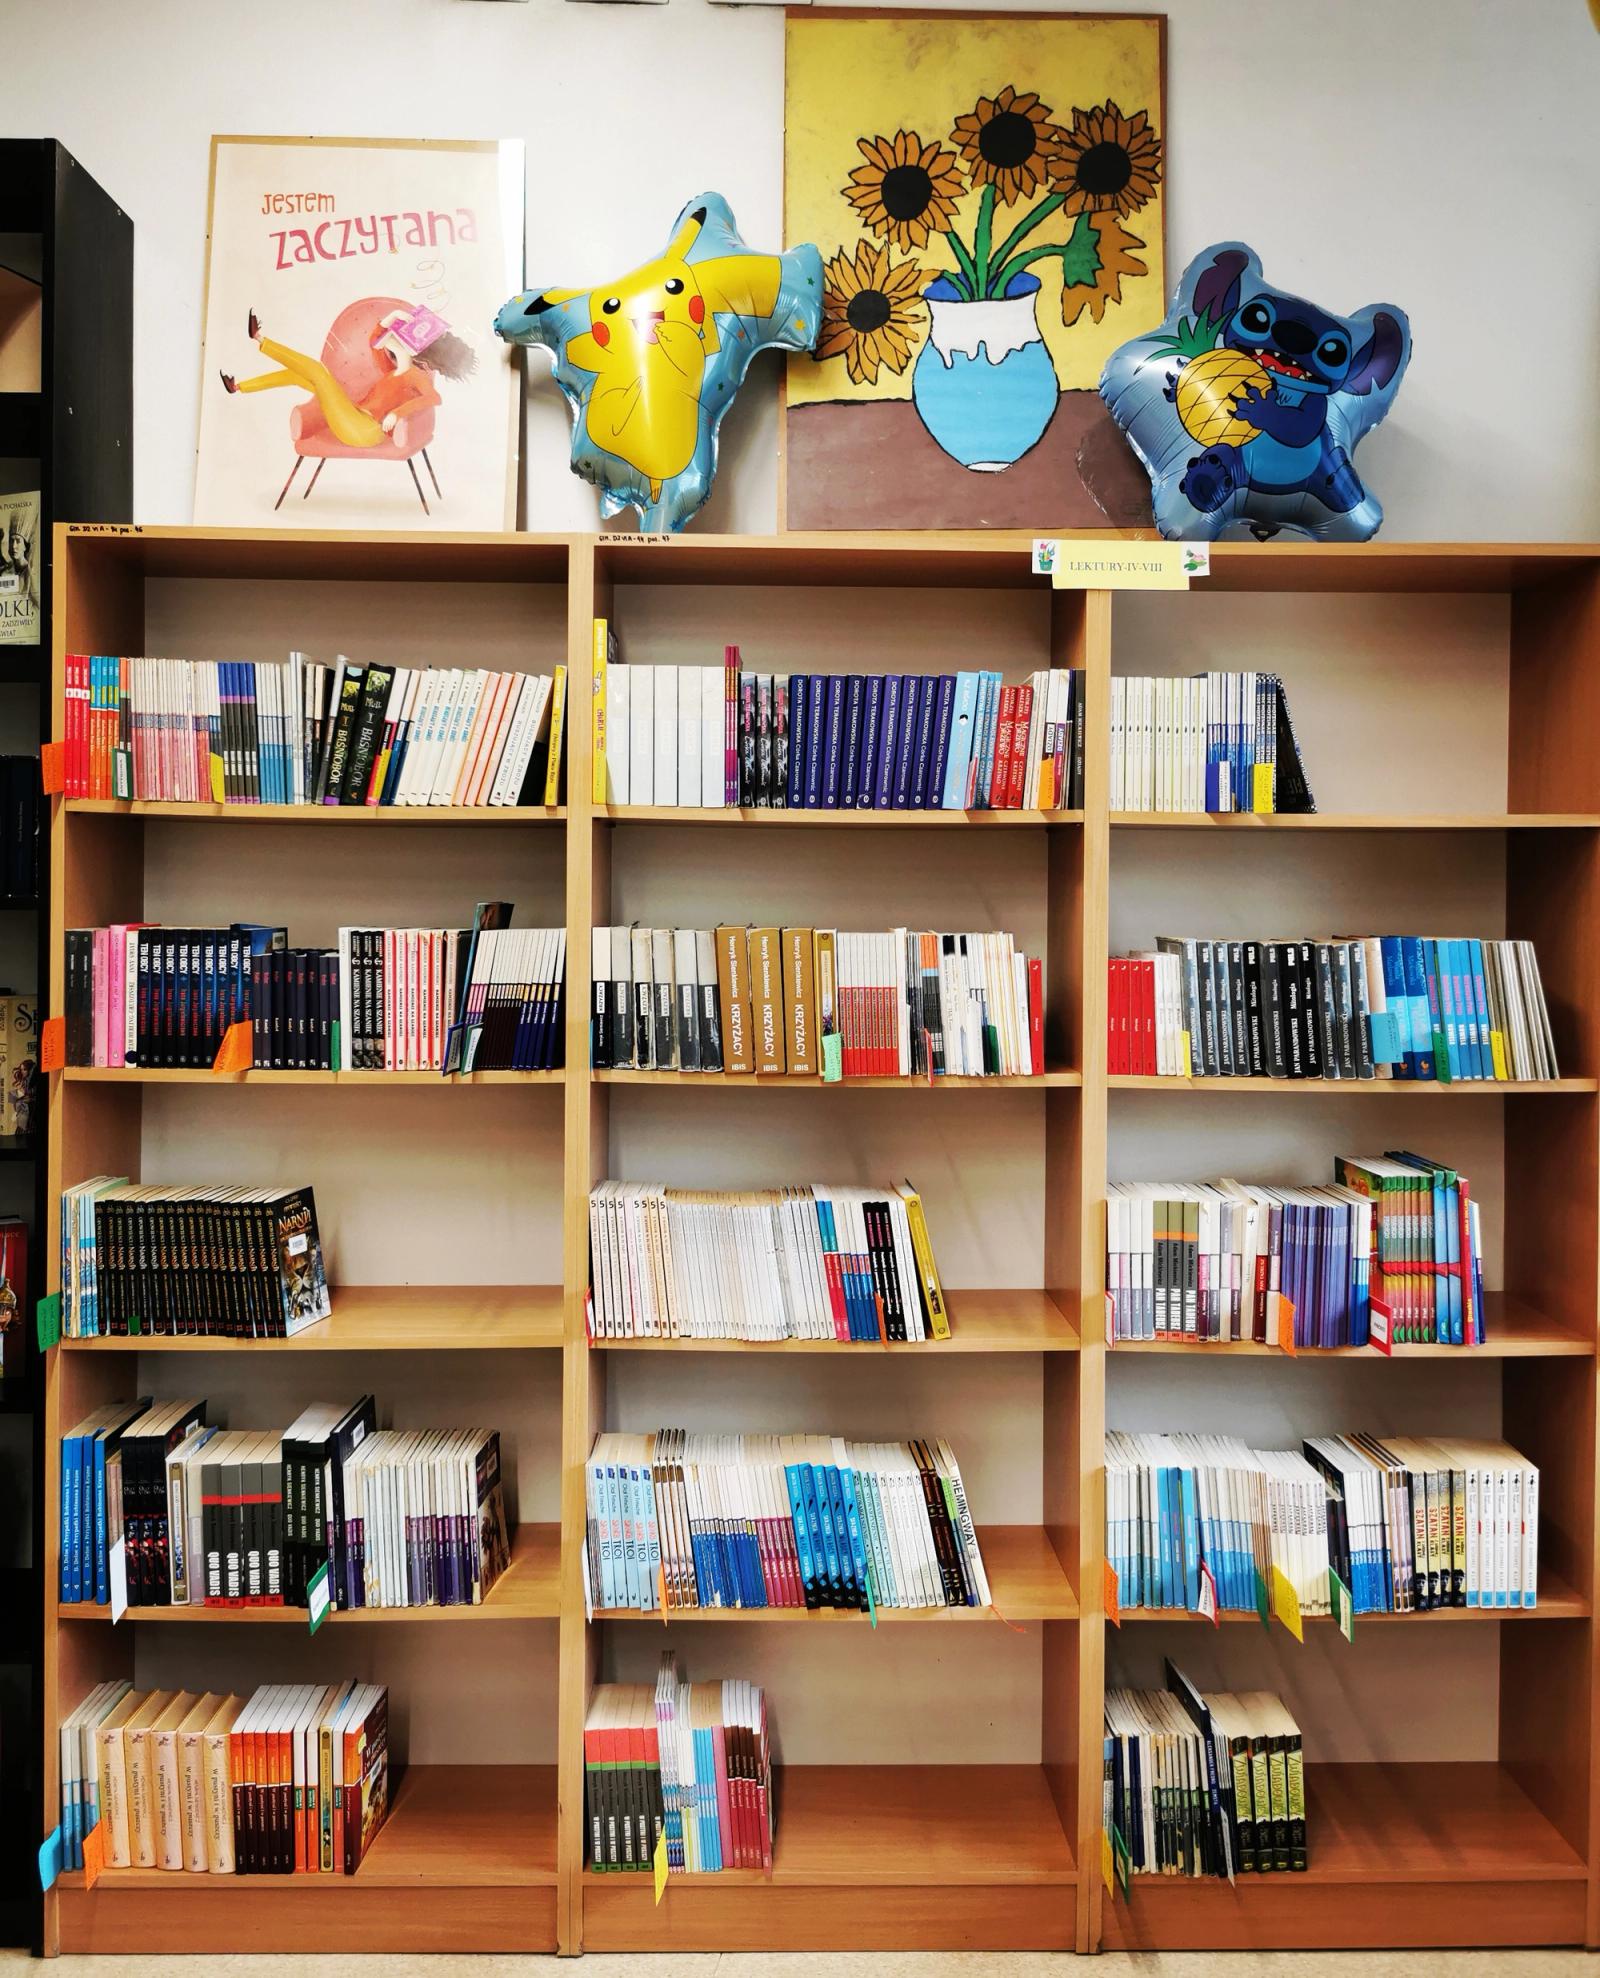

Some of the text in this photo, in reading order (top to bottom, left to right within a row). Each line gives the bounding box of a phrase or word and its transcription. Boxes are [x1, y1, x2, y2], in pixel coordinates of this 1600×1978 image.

[1069, 561, 1162, 573] LEKTURY-IV-VIII
[812, 706, 820, 744] TERAKOWSKA
[831, 707, 839, 744] TERAKOWSKA
[886, 708, 895, 745] TERAKOWSKA
[330, 730, 348, 784] BAŚNIOBÓR
[140, 956, 148, 972] OBCY
[153, 944, 161, 974] TEN OBCY
[166, 945, 174, 974] TEN OBCY
[205, 945, 213, 975] TEN OBCY
[353, 1000, 360, 1008] NA
[365, 1000, 372, 1008] NA
[376, 1000, 382, 1008] NA
[729, 936, 744, 1056] Henryk Sienkiewicz KRZYŻACY
[761, 936, 775, 1057] Henryk Sienkiewicz KRZYŻACY
[793, 936, 807, 1057] Henryk Sienkiewicz KRZYŻACY
[1251, 1016, 1260, 1058] PARANDOWSKI
[1291, 1018, 1300, 1061] PARANDOWSKI
[1306, 1009, 1315, 1052] PARANDOWSKI
[1156, 1288, 1166, 1300] PAN
[1171, 1289, 1181, 1302] PAN
[1186, 1290, 1196, 1303] PAN
[1156, 1302, 1166, 1329] TADEUSZ
[1171, 1303, 1181, 1330] TADEUSZ
[1186, 1304, 1196, 1331] TADEUSZ
[952, 1479, 975, 1546] HEMINGWAY
[1416, 1510, 1424, 1540] SZATAN
[1430, 1508, 1440, 1538] SZATAN
[1441, 1505, 1450, 1536] SZATAN
[1455, 1506, 1464, 1536] SZATAN
[601, 1541, 610, 1560] TROI
[613, 1540, 623, 1559] TROI
[626, 1541, 636, 1560] TROI
[208, 1552, 220, 1596] QUO VADIS
[227, 1553, 239, 1597] QUO VADIS
[248, 1551, 260, 1595] QUO VADIS
[267, 1550, 280, 1594] QUO VADIS
